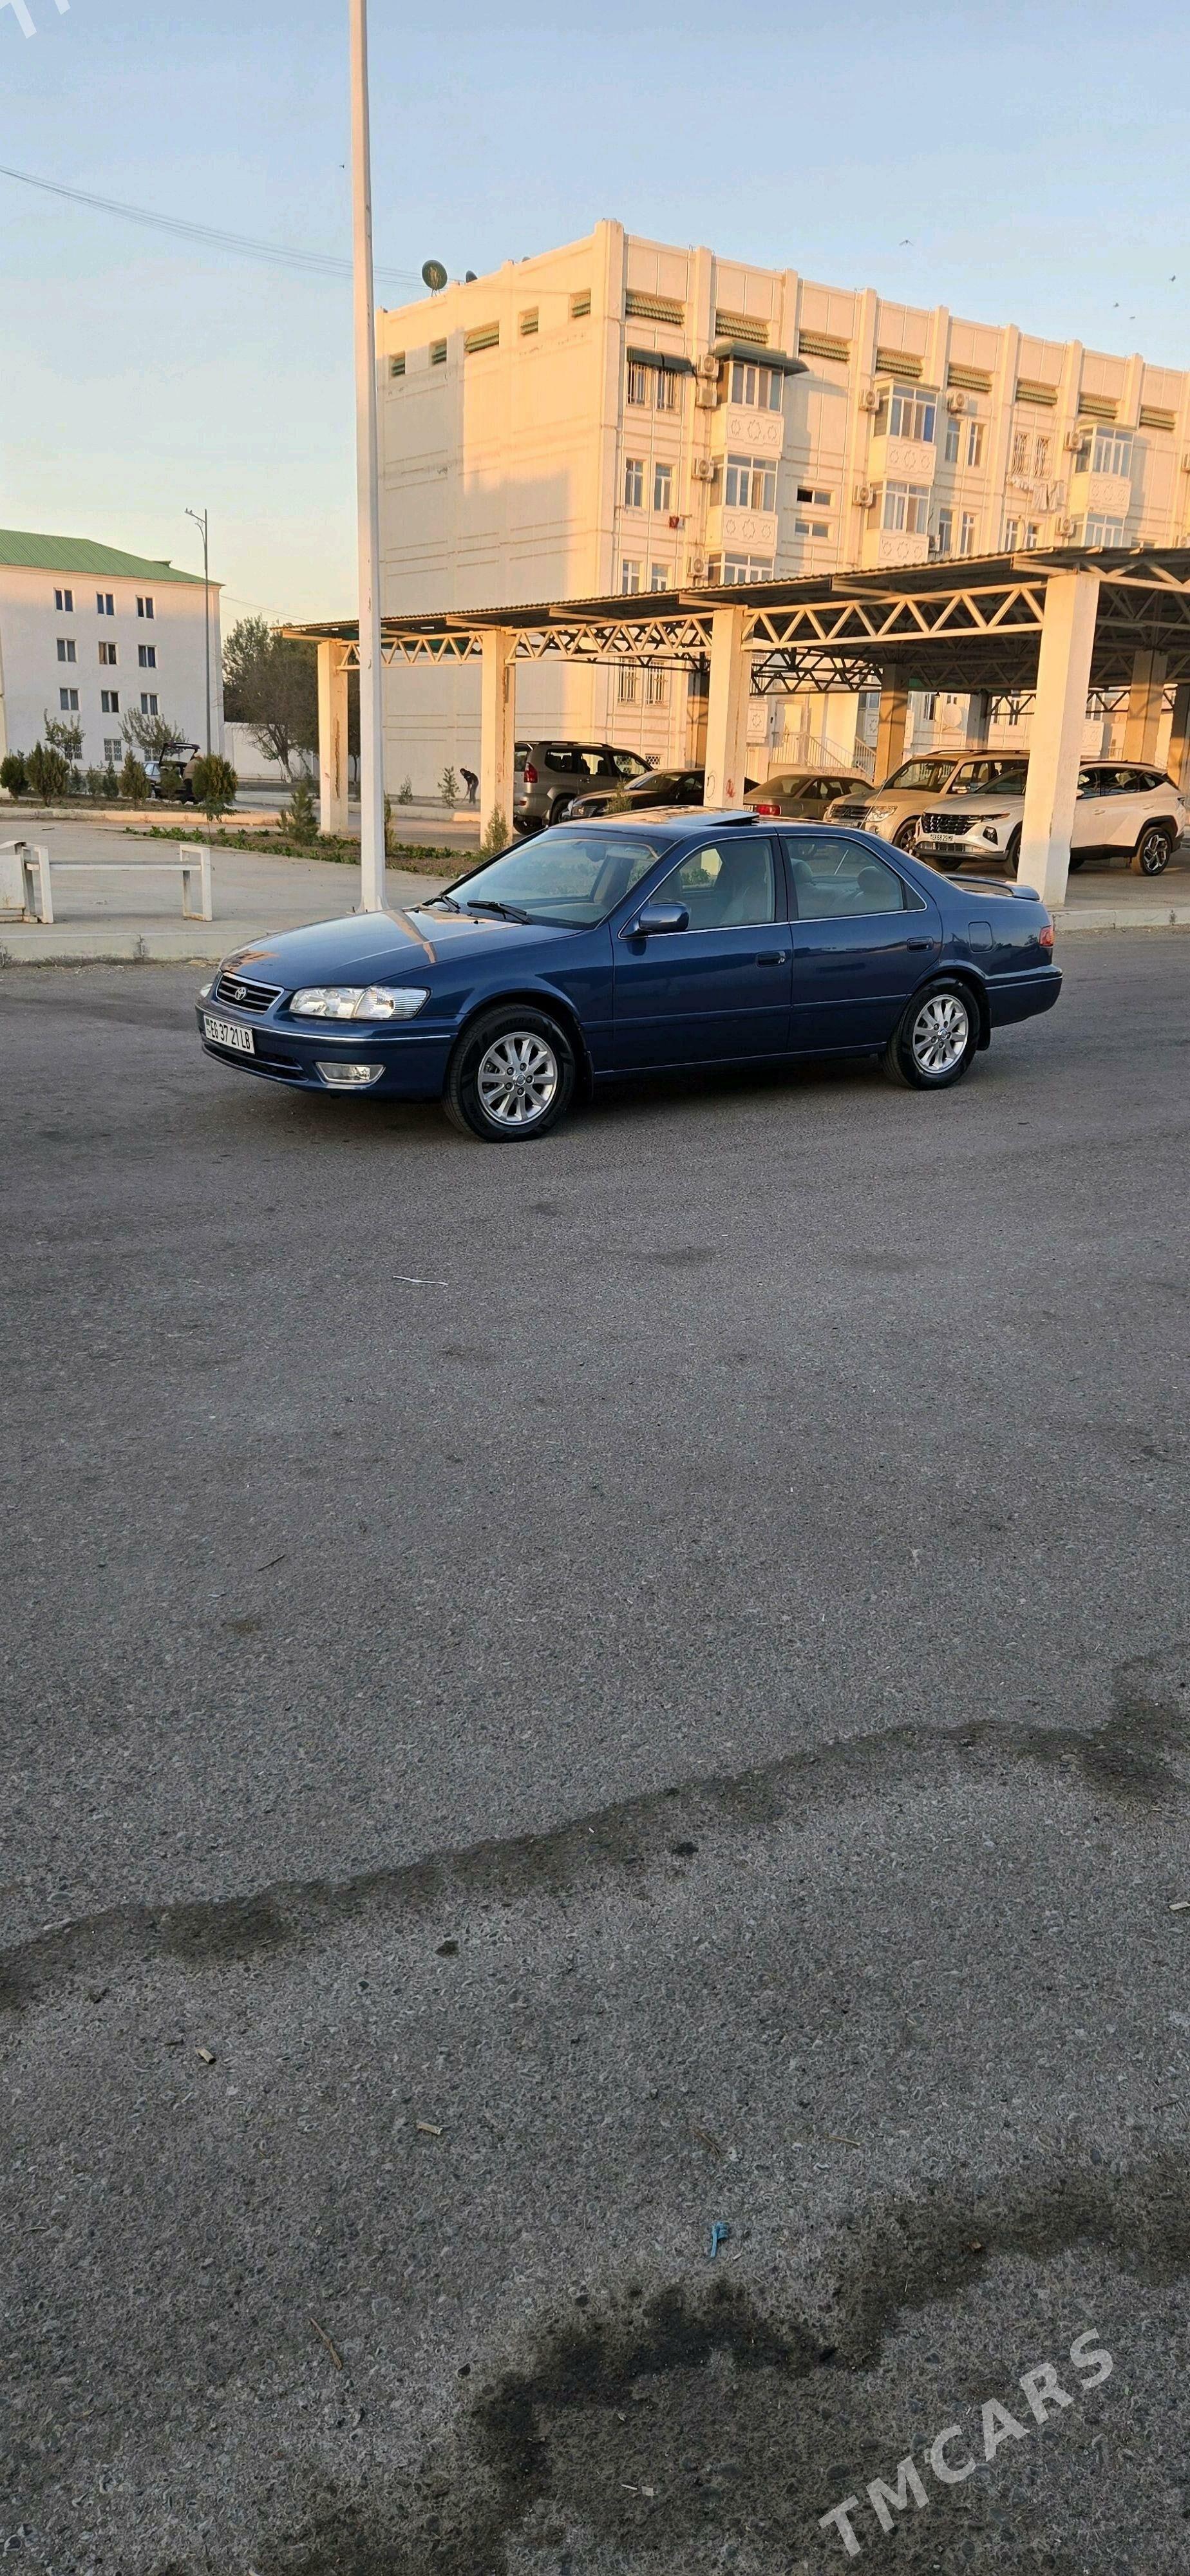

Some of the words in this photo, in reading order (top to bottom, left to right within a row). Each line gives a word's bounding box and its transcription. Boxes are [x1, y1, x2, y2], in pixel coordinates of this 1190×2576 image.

[210, 1020, 218, 1039] EG
[219, 1023, 228, 1042] 37
[230, 1027, 239, 1046] 21
[240, 1030, 250, 1049] LB
